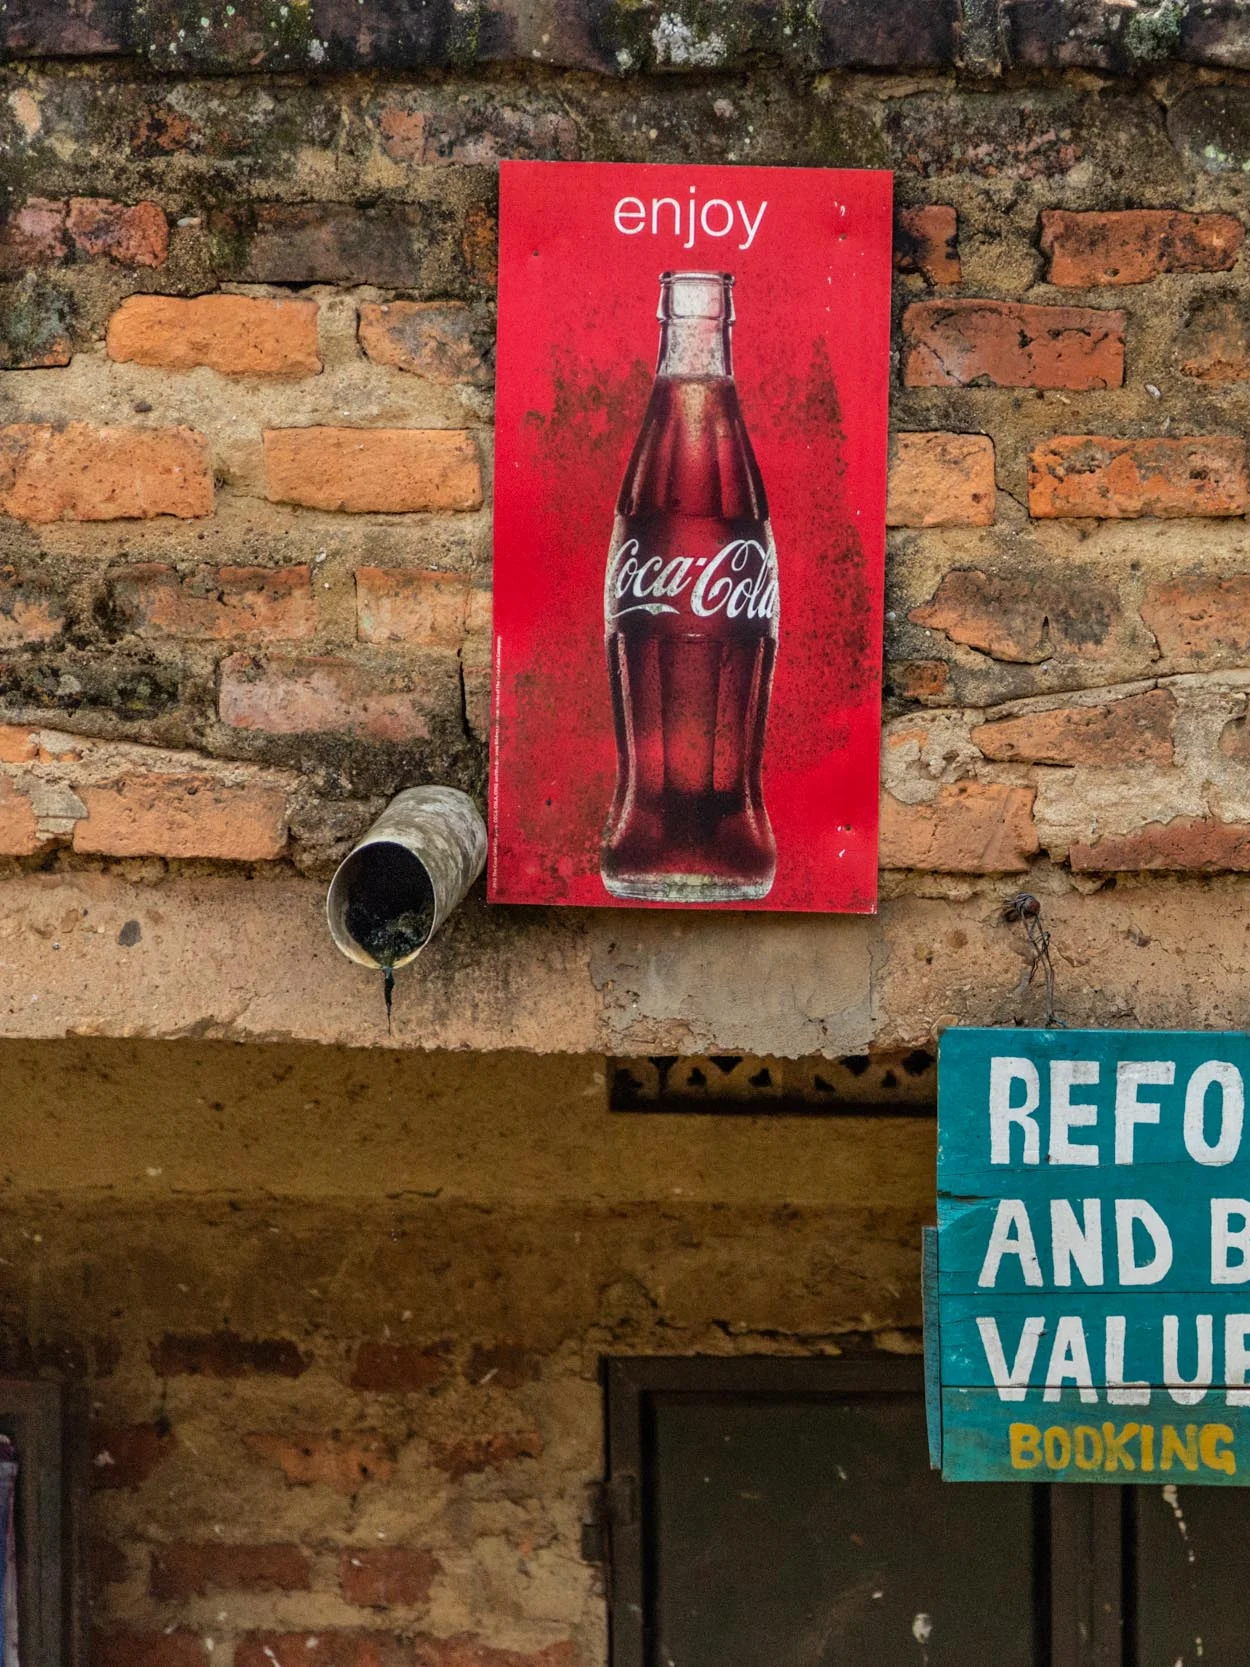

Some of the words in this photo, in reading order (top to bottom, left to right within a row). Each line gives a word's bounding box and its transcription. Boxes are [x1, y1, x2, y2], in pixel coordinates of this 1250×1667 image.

[613, 186, 768, 251] enjoy
[608, 538, 778, 619] Coca-Cola
[977, 1198, 1173, 1288] AND
[1009, 1421, 1236, 1476] BOOKING
